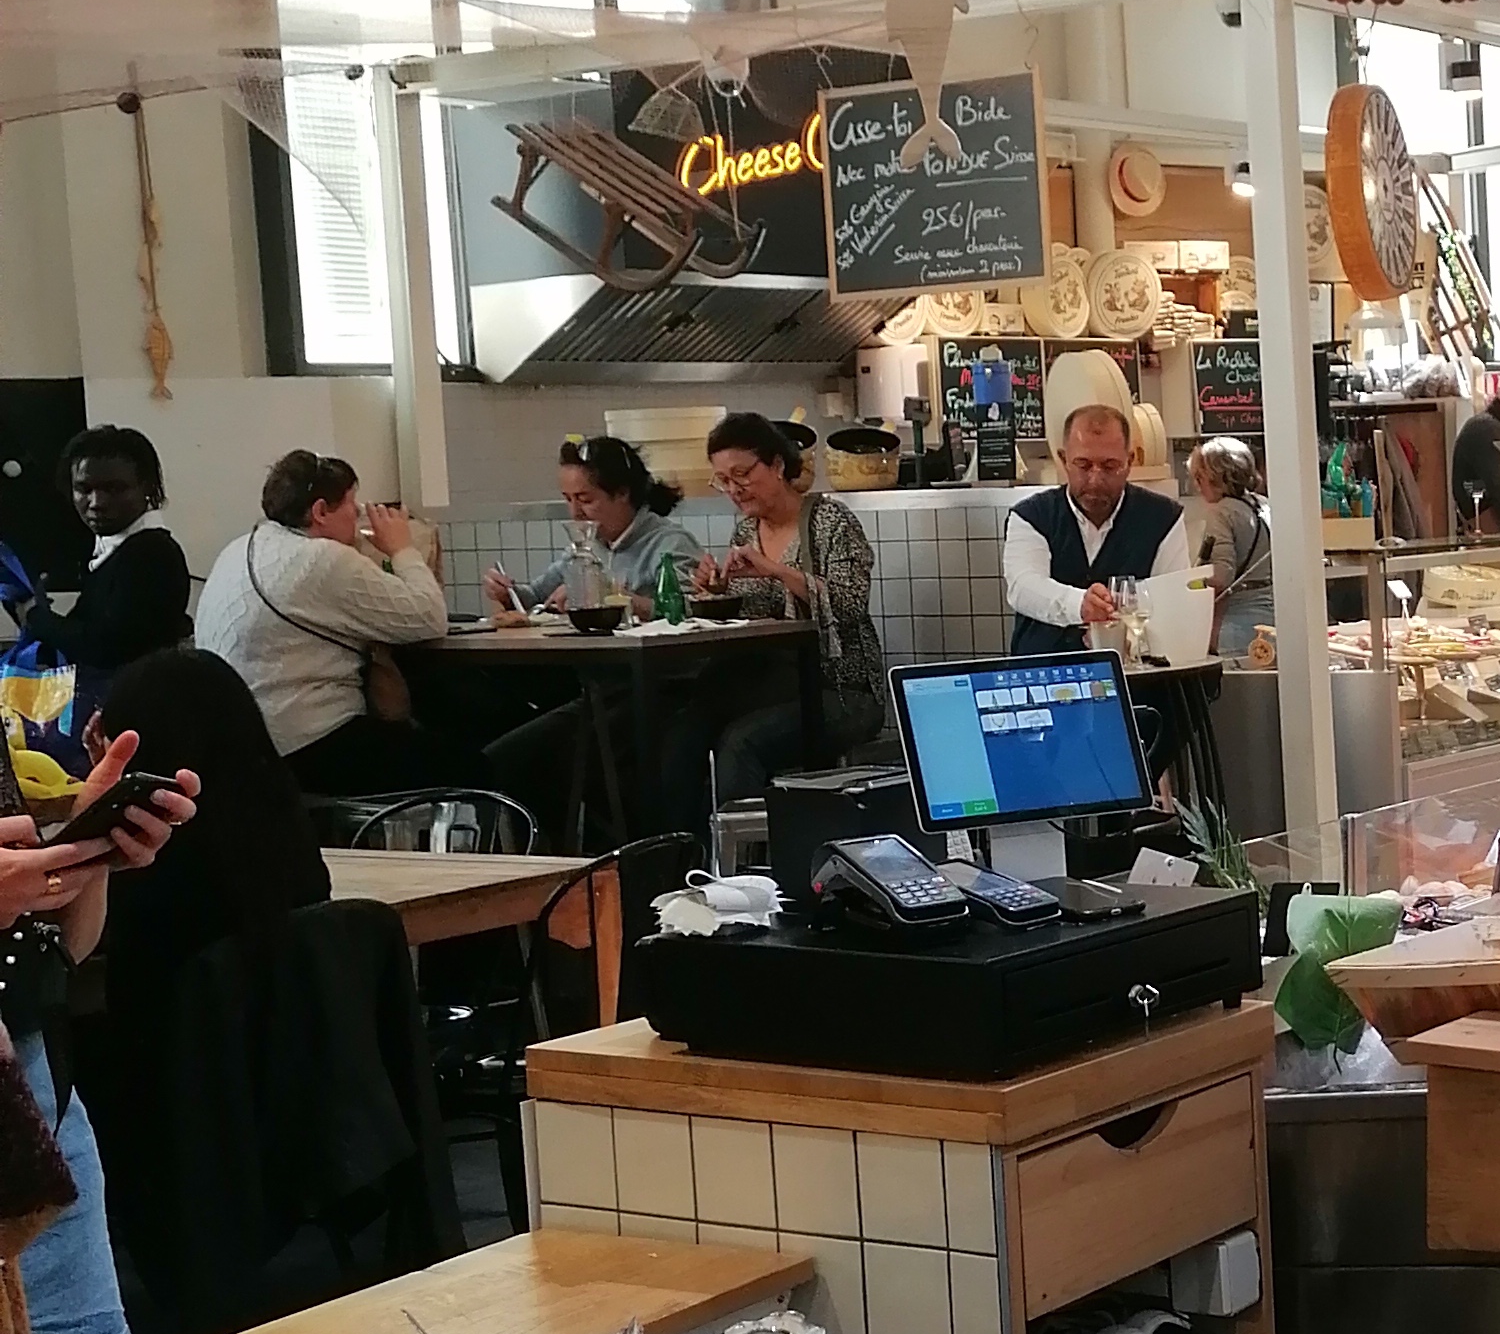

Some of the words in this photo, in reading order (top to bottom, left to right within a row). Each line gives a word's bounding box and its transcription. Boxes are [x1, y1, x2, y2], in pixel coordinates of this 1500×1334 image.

[954, 94, 1012, 127] Bide
[677, 133, 802, 198] Cheese
[993, 135, 1035, 171] Suisse
